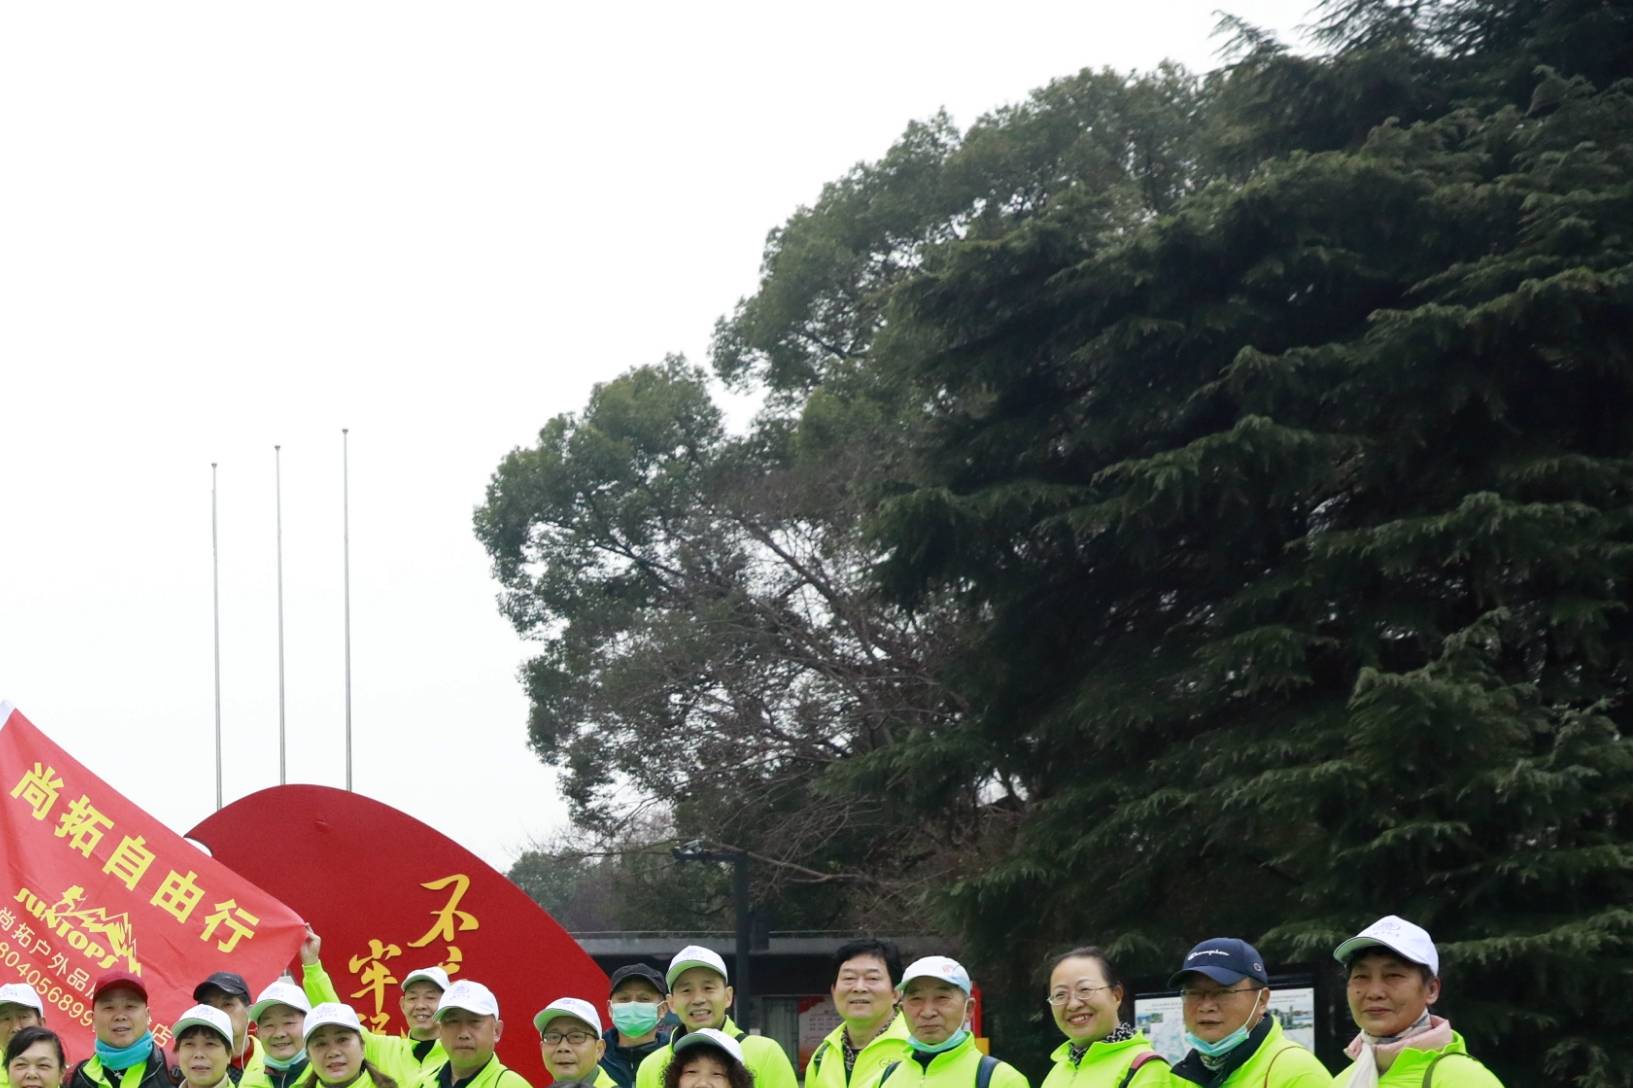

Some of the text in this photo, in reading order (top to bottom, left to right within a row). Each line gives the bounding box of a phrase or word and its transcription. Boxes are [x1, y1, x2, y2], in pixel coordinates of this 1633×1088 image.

[9, 761, 260, 954] 尚拓自由行
[407, 873, 480, 976] 不
